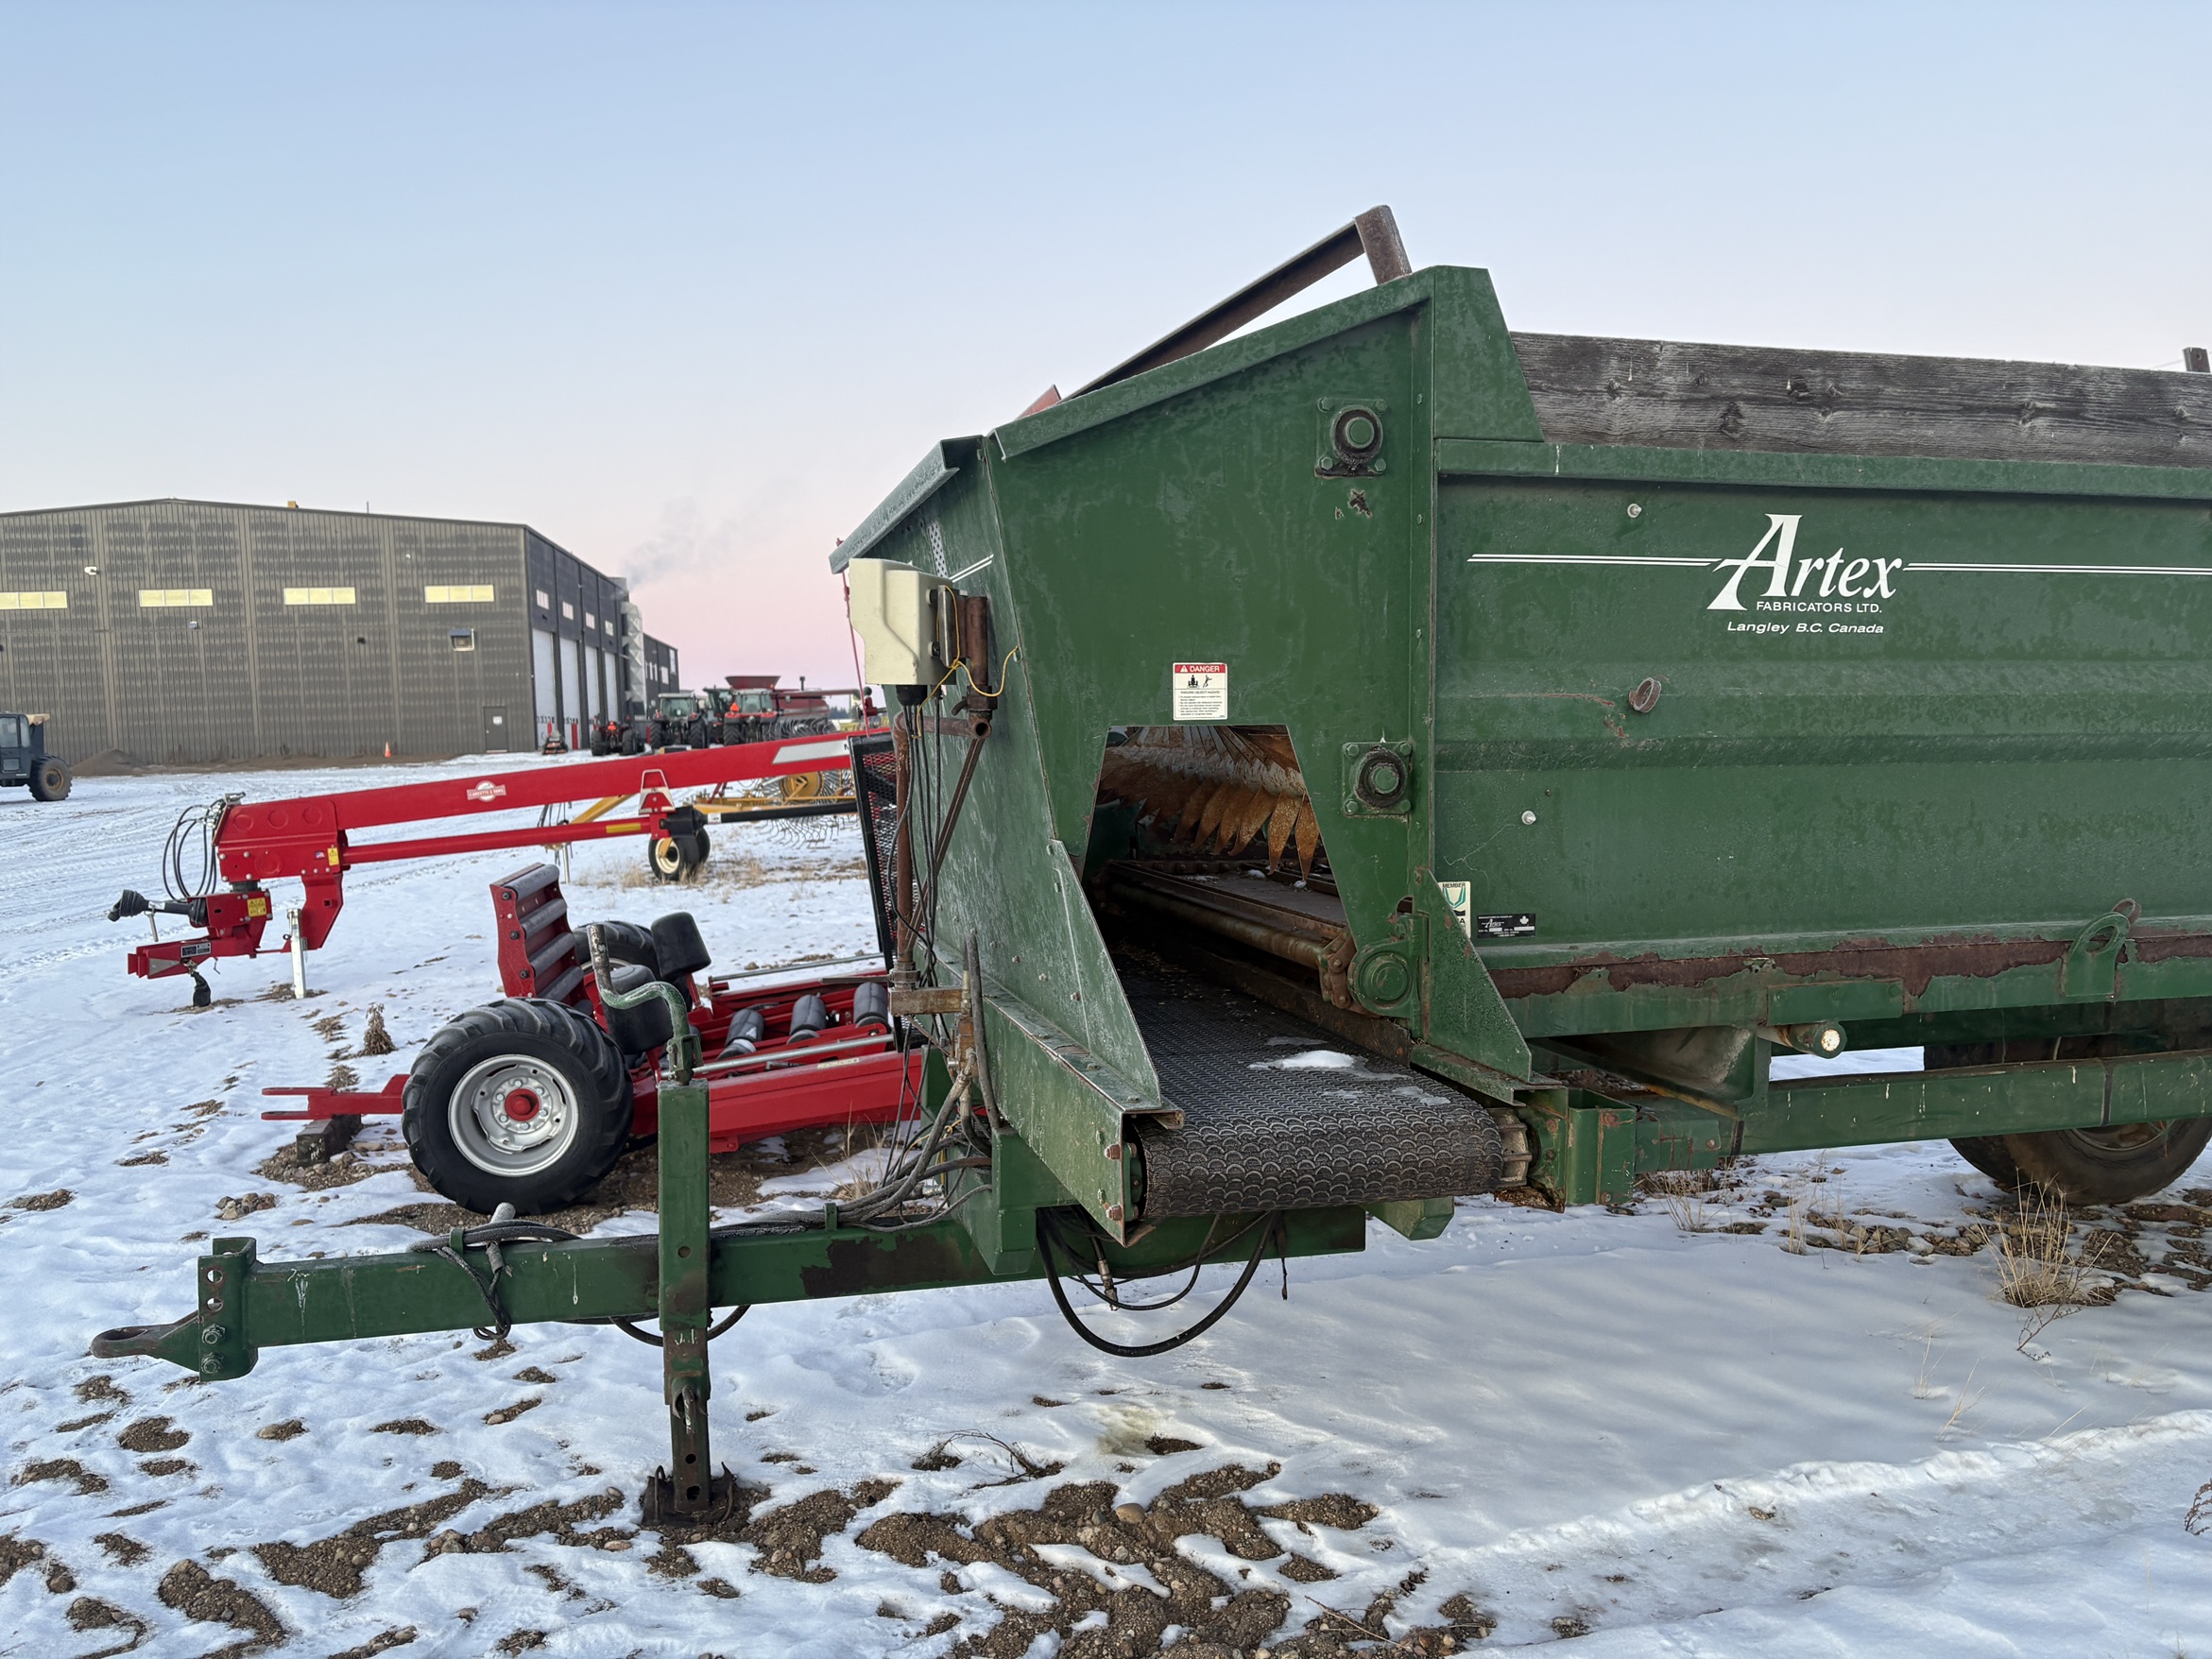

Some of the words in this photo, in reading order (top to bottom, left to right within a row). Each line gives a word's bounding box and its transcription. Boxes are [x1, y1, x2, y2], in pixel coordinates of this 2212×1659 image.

[1706, 513, 1902, 610] Artex
[1757, 601, 1852, 613] FABRICATORS
[1856, 603, 1882, 613] LTD.
[1727, 621, 1790, 634] Langley
[1795, 623, 1824, 633] B.C.
[1828, 623, 1884, 634] Canada
